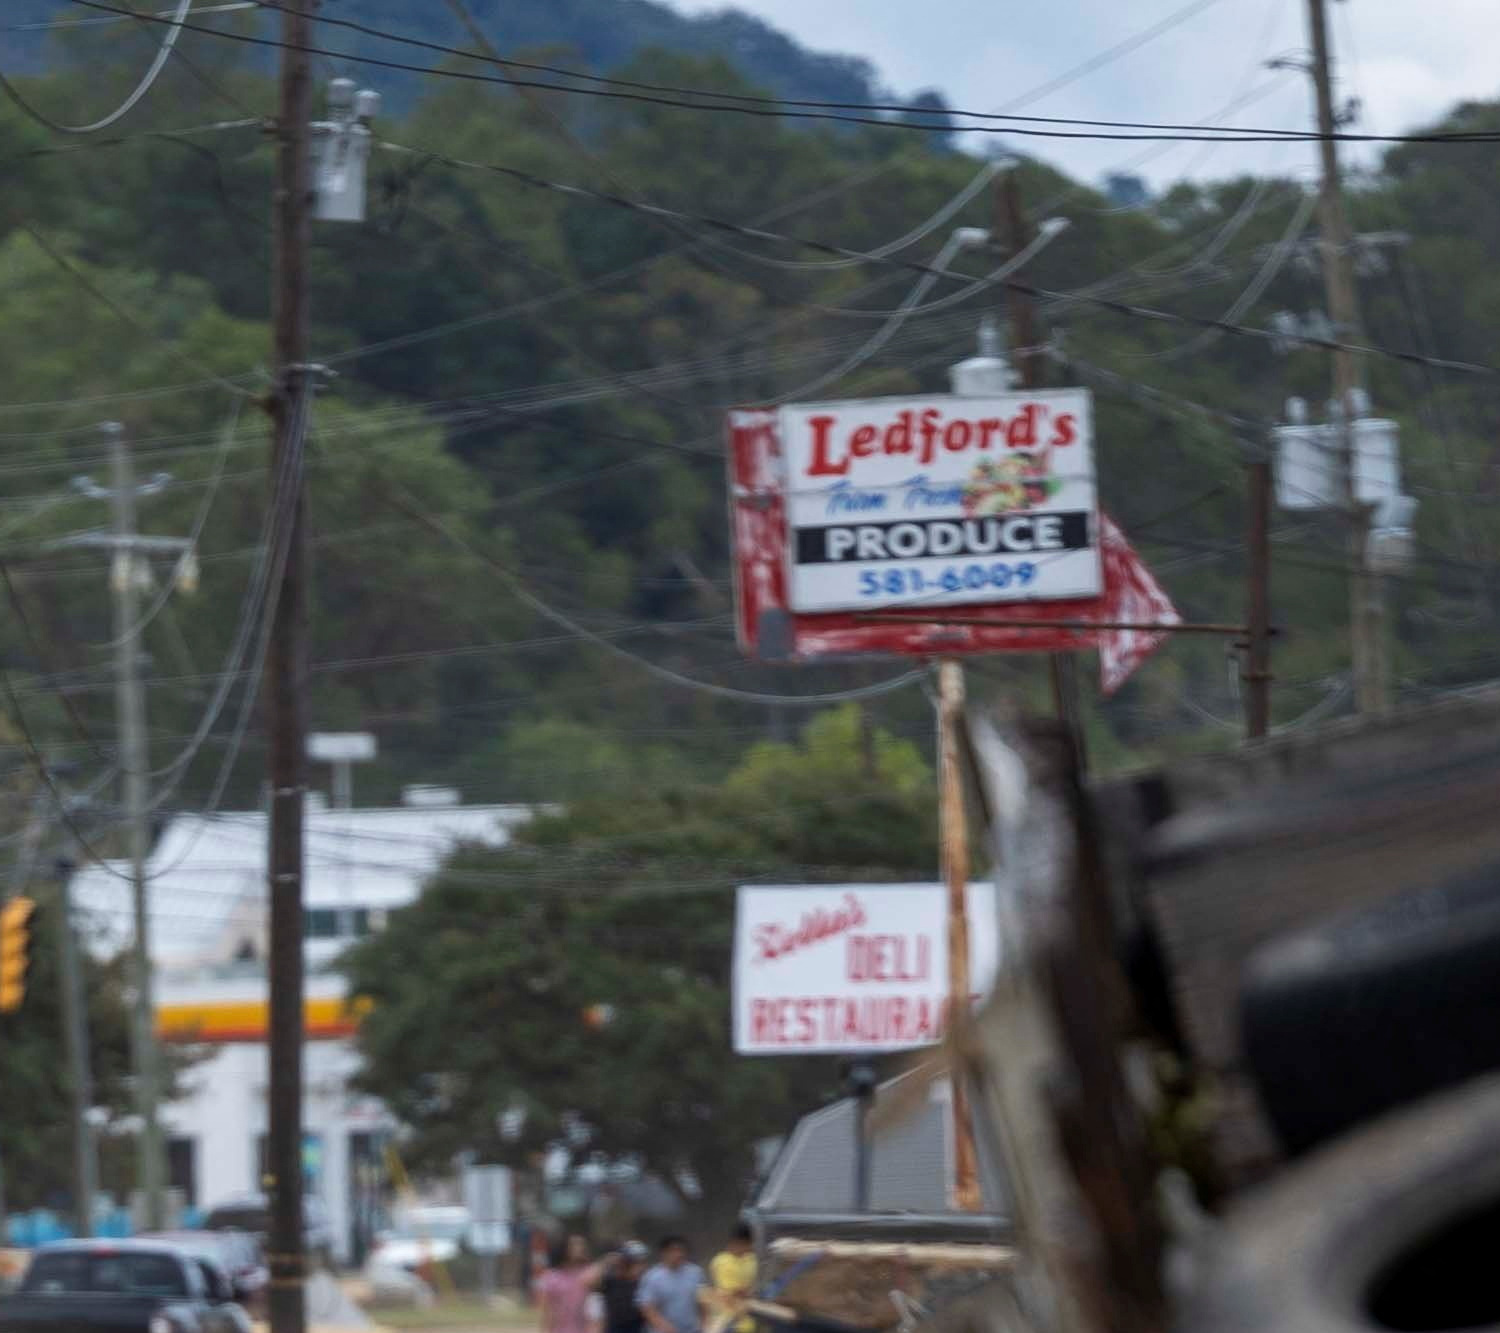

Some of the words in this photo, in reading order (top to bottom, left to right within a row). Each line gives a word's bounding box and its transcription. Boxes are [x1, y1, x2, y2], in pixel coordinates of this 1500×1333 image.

[806, 402, 1076, 476] Ledford's
[825, 516, 1064, 561] PRODUCE
[847, 934, 930, 982] DELI
[750, 993, 984, 1044] RESTAURA
